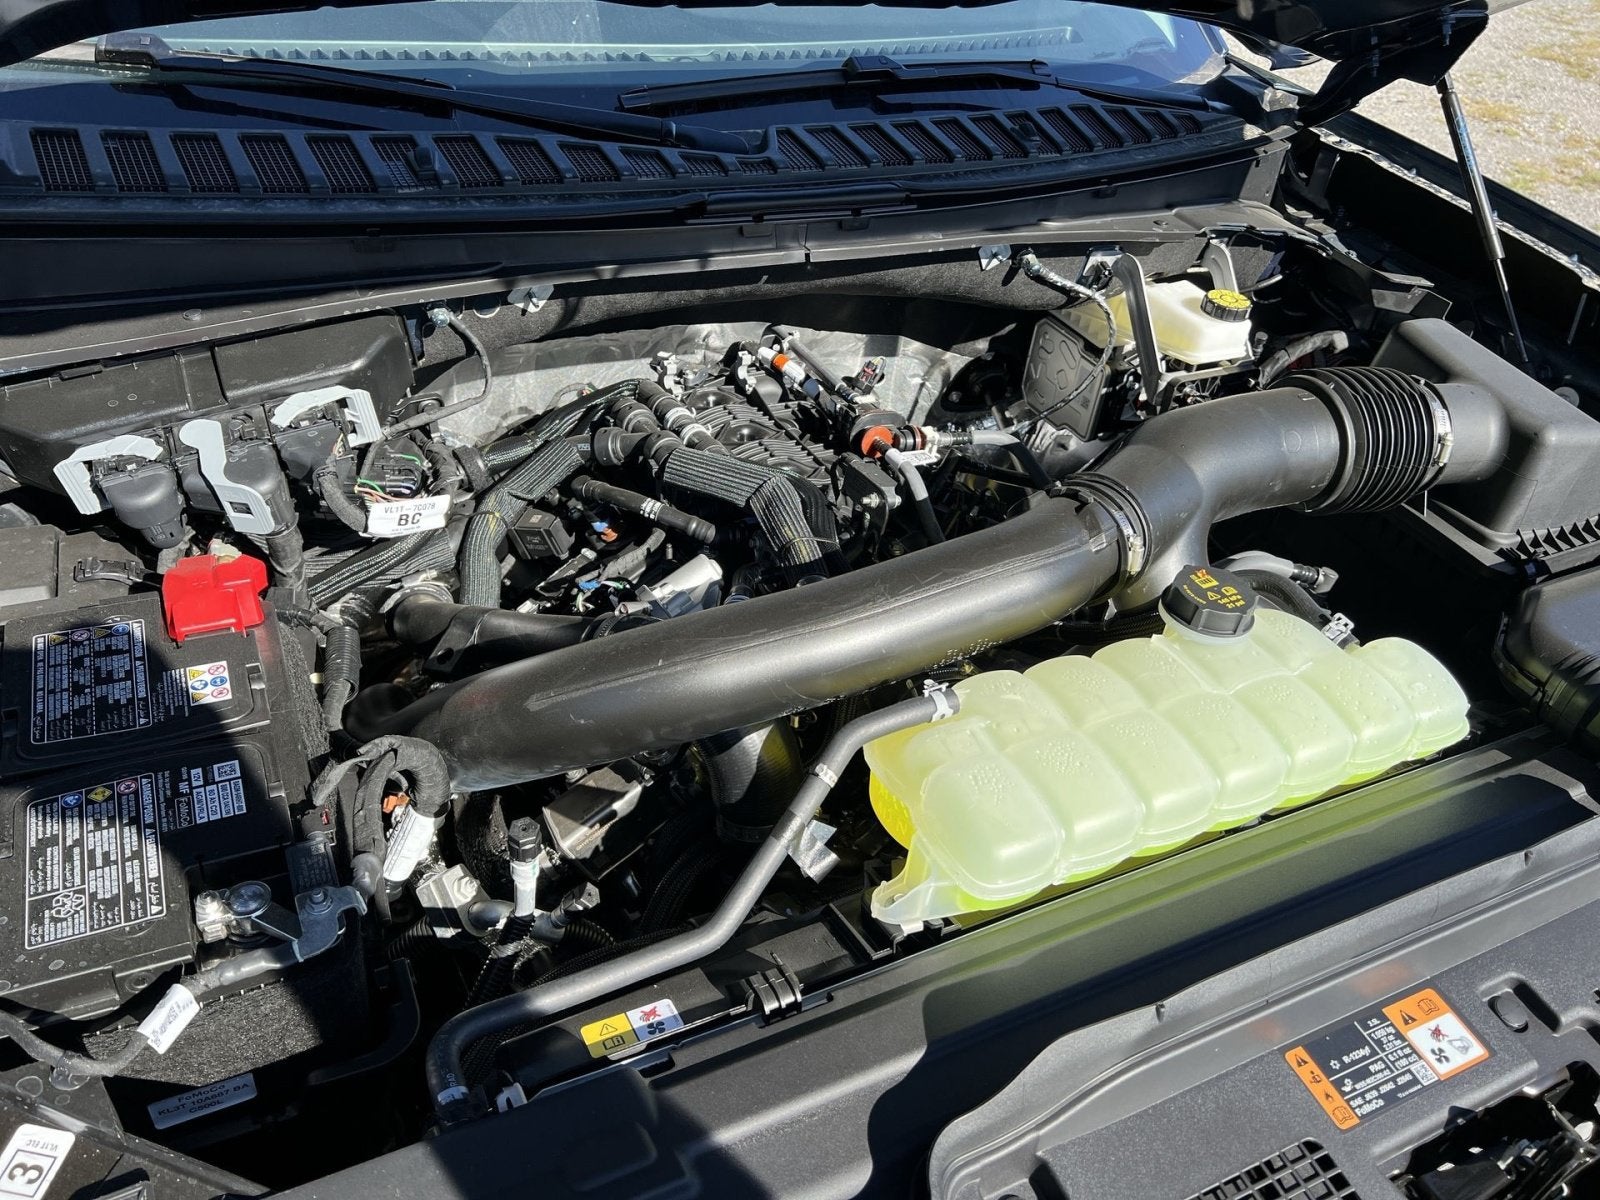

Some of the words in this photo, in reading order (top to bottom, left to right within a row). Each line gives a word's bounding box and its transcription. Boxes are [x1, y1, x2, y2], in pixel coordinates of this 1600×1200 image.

[398, 512, 422, 526] BC
[192, 772, 201, 782] 12V
[179, 798, 190, 827] FoMoCo
[210, 805, 218, 816] C20
[1341, 1045, 1371, 1064] R-1234yf
[1368, 1061, 1386, 1073] PAG
[178, 1084, 226, 1103] FoMoCo
[158, 1103, 186, 1116] KL3T
[1349, 1097, 1364, 1108] SAE
[1354, 1099, 1385, 1117] FoMoCo
[8, 1161, 45, 1186] 3
